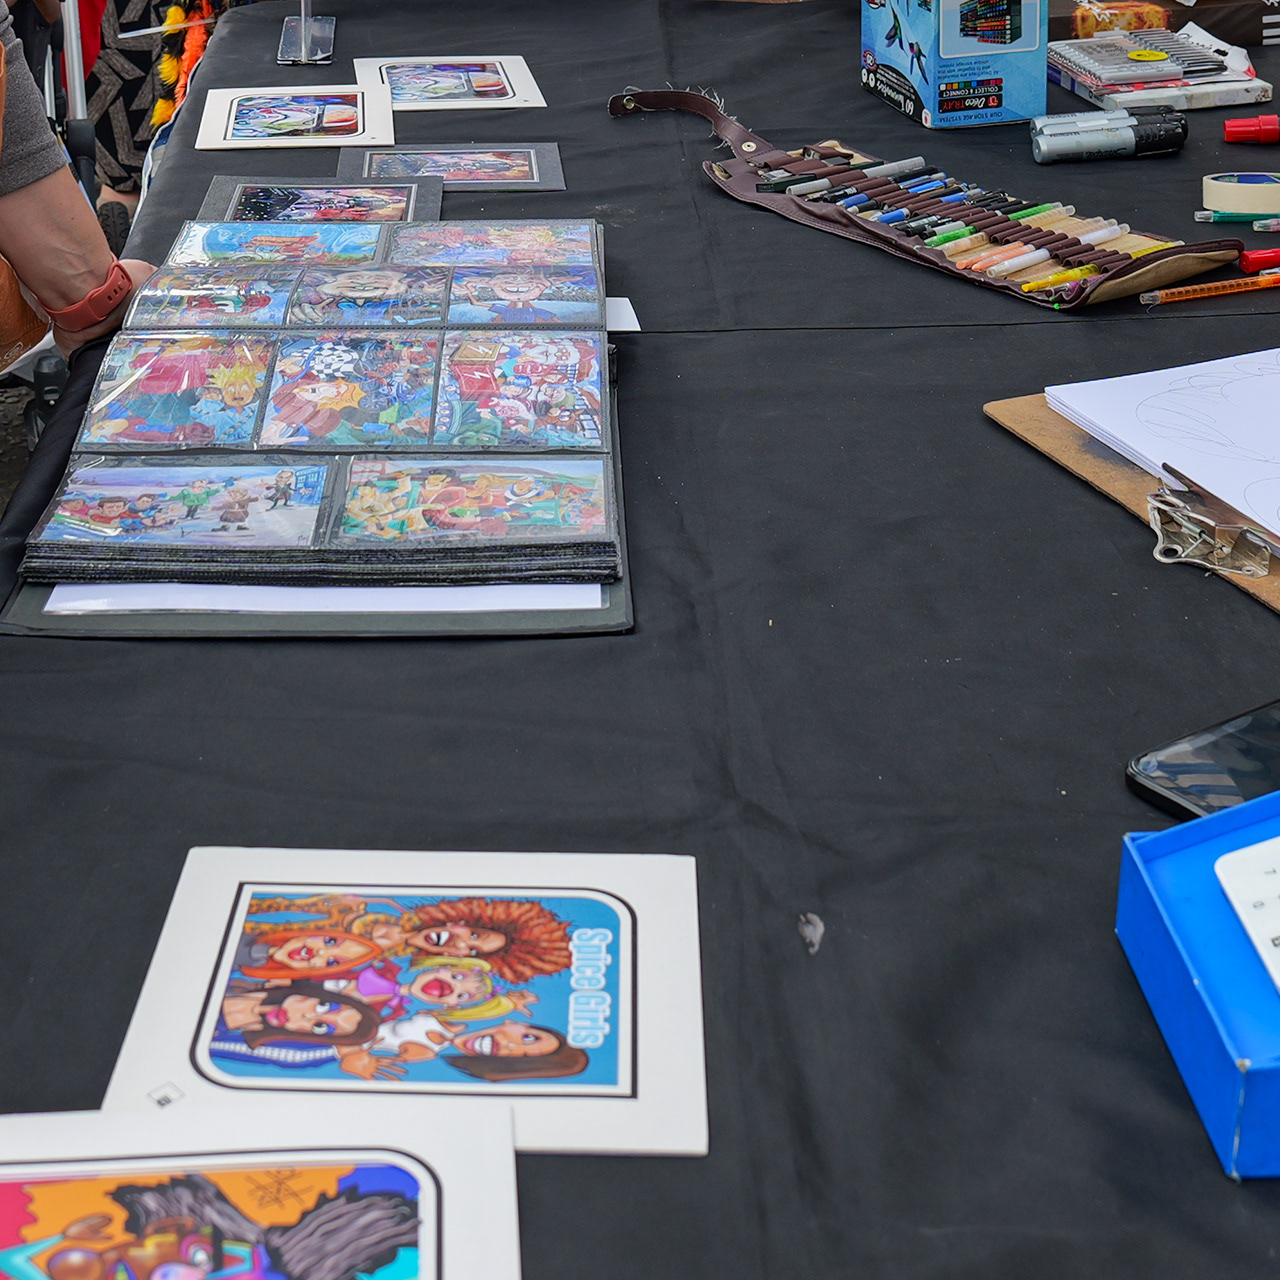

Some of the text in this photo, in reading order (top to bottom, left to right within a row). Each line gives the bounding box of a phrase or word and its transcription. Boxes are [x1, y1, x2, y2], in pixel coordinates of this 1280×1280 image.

[943, 88, 969, 97] CONNECT
[975, 86, 999, 94] COLLECT
[567, 927, 612, 1049] Spice Girls
